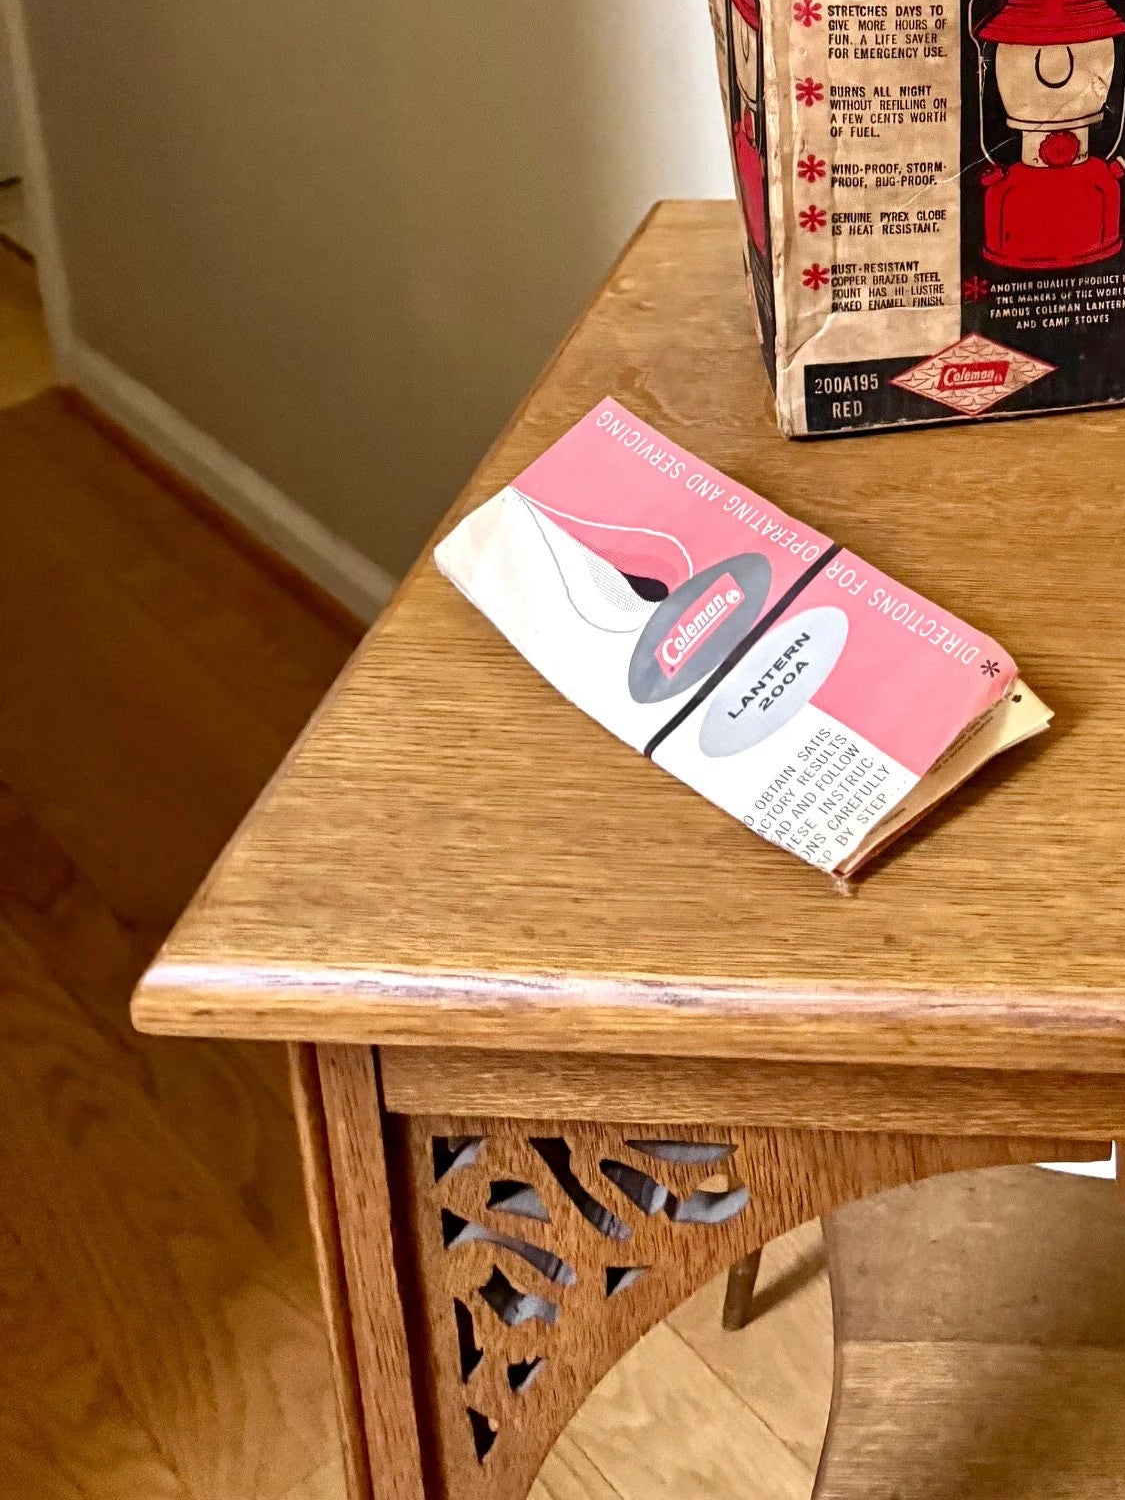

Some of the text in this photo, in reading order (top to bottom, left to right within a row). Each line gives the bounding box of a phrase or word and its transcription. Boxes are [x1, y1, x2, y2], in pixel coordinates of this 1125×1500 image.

[827, 5, 944, 17] STRETCHES DAYS TO
[828, 19, 947, 31] GIVE MORE HOURS OF
[860, 34, 867, 45] A
[875, 34, 897, 44] LIFE
[905, 33, 938, 44] SAVER
[828, 46, 948, 59] FOR EMERGENCY USE.
[830, 85, 932, 97] BURNS ALL NIGHT
[830, 98, 947, 111] WITHOUT REFILLING ON
[830, 111, 947, 124] A FEW CENTS WORTH
[830, 126, 880, 137] OF FUEL.
[831, 161, 947, 175] WIND-PROOF, STORM-
[831, 175, 938, 188] PROOF, BUG-PROOF.
[831, 210, 947, 224] GENUINE PYREX GLOBE
[831, 222, 940, 236] IS HEAT RESISTANT.
[831, 260, 920, 275] RUST-RESISTANT
[831, 271, 941, 287] COPPER BRAZED STEEL
[990, 279, 1034, 293] ANOTHER
[1036, 277, 1076, 290] QUALITY
[1078, 274, 1119, 287] PRODUCT
[832, 284, 945, 299] FOUNT HAS HI-LUSTRE
[996, 296, 1014, 305] THE
[1017, 293, 1057, 303] MAKERS
[1060, 291, 1072, 300] OF
[1075, 289, 1093, 299] THE
[868, 298, 906, 310] ENAMEL
[990, 307, 1030, 319] FAMOUS
[1036, 303, 1081, 315] COLEMAN
[1016, 314, 1110, 330] AND CAMP STOVES
[814, 373, 879, 395] 200A195
[943, 367, 996, 386] Coleman
[832, 400, 863, 419] RED
[596, 410, 980, 664] DIRECTIONS FOR OPERATING AND SERVICING
[662, 594, 727, 665] Coleman
[727, 632, 811, 720] LANTERN
[758, 659, 810, 712] 200A
[754, 765, 797, 811] OBTAIN
[757, 734, 848, 837] ACTORY RESULTS
[791, 791, 817, 820] AND
[815, 743, 861, 792] FOLLOW
[827, 764, 890, 831] CAREFULLY
[835, 827, 854, 847] BY
